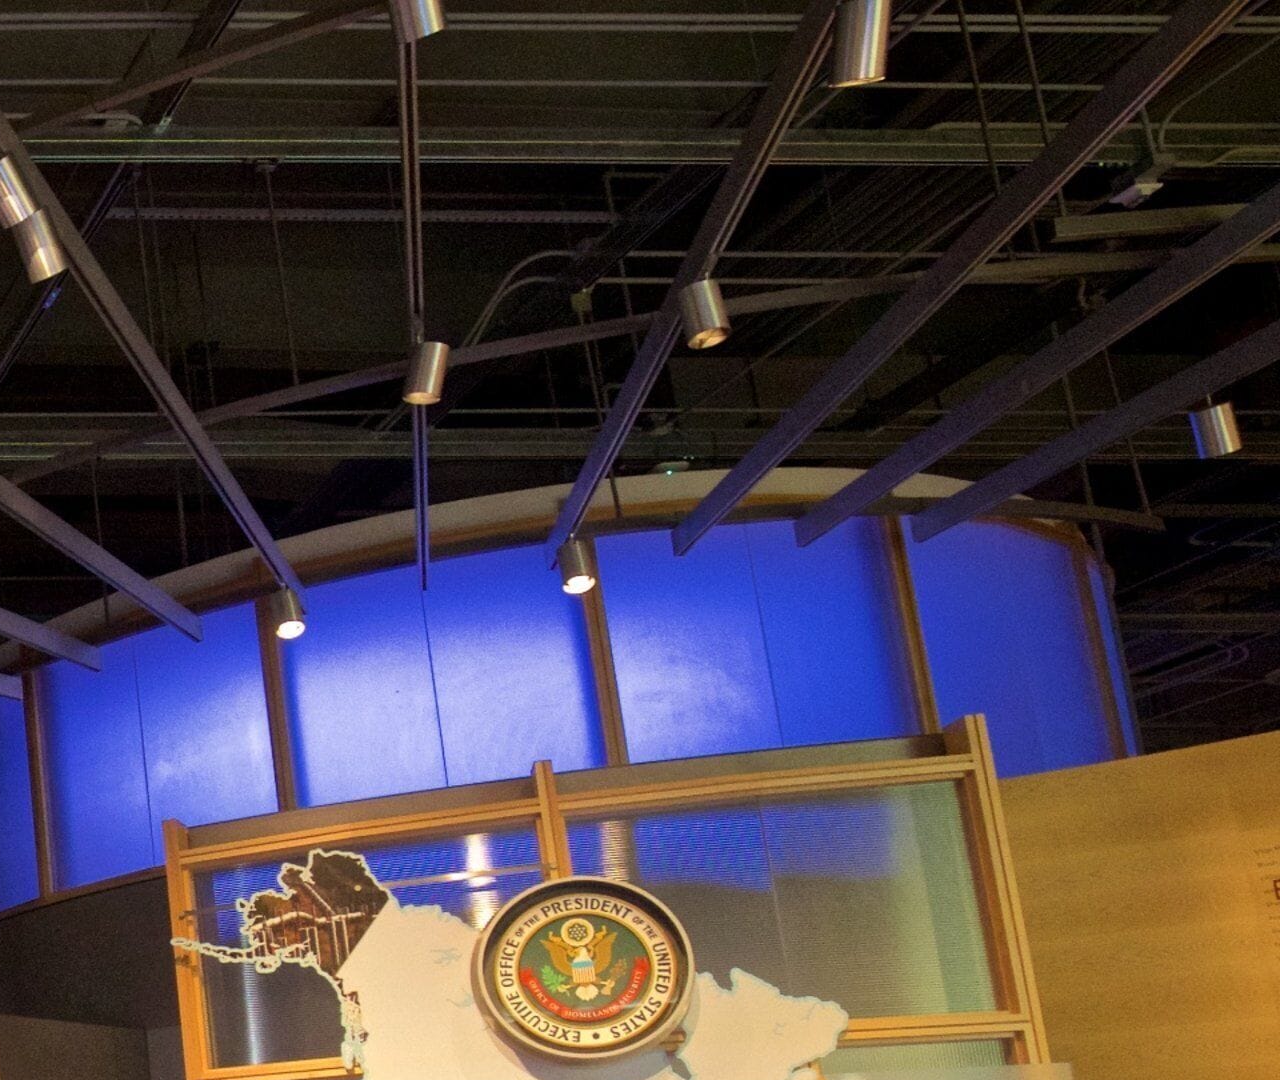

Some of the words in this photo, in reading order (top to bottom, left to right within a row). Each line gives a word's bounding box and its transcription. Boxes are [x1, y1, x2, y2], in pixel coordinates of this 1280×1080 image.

[540, 898, 633, 920] PRESIDENT
[524, 914, 541, 928] THE
[631, 916, 642, 926] OF
[642, 923, 658, 940] THE
[515, 927, 526, 938] OF
[500, 938, 519, 988] OFFICE
[652, 941, 672, 994] UNITED
[506, 991, 581, 1042] EXECUTIVE
[609, 996, 662, 1038] STATES
